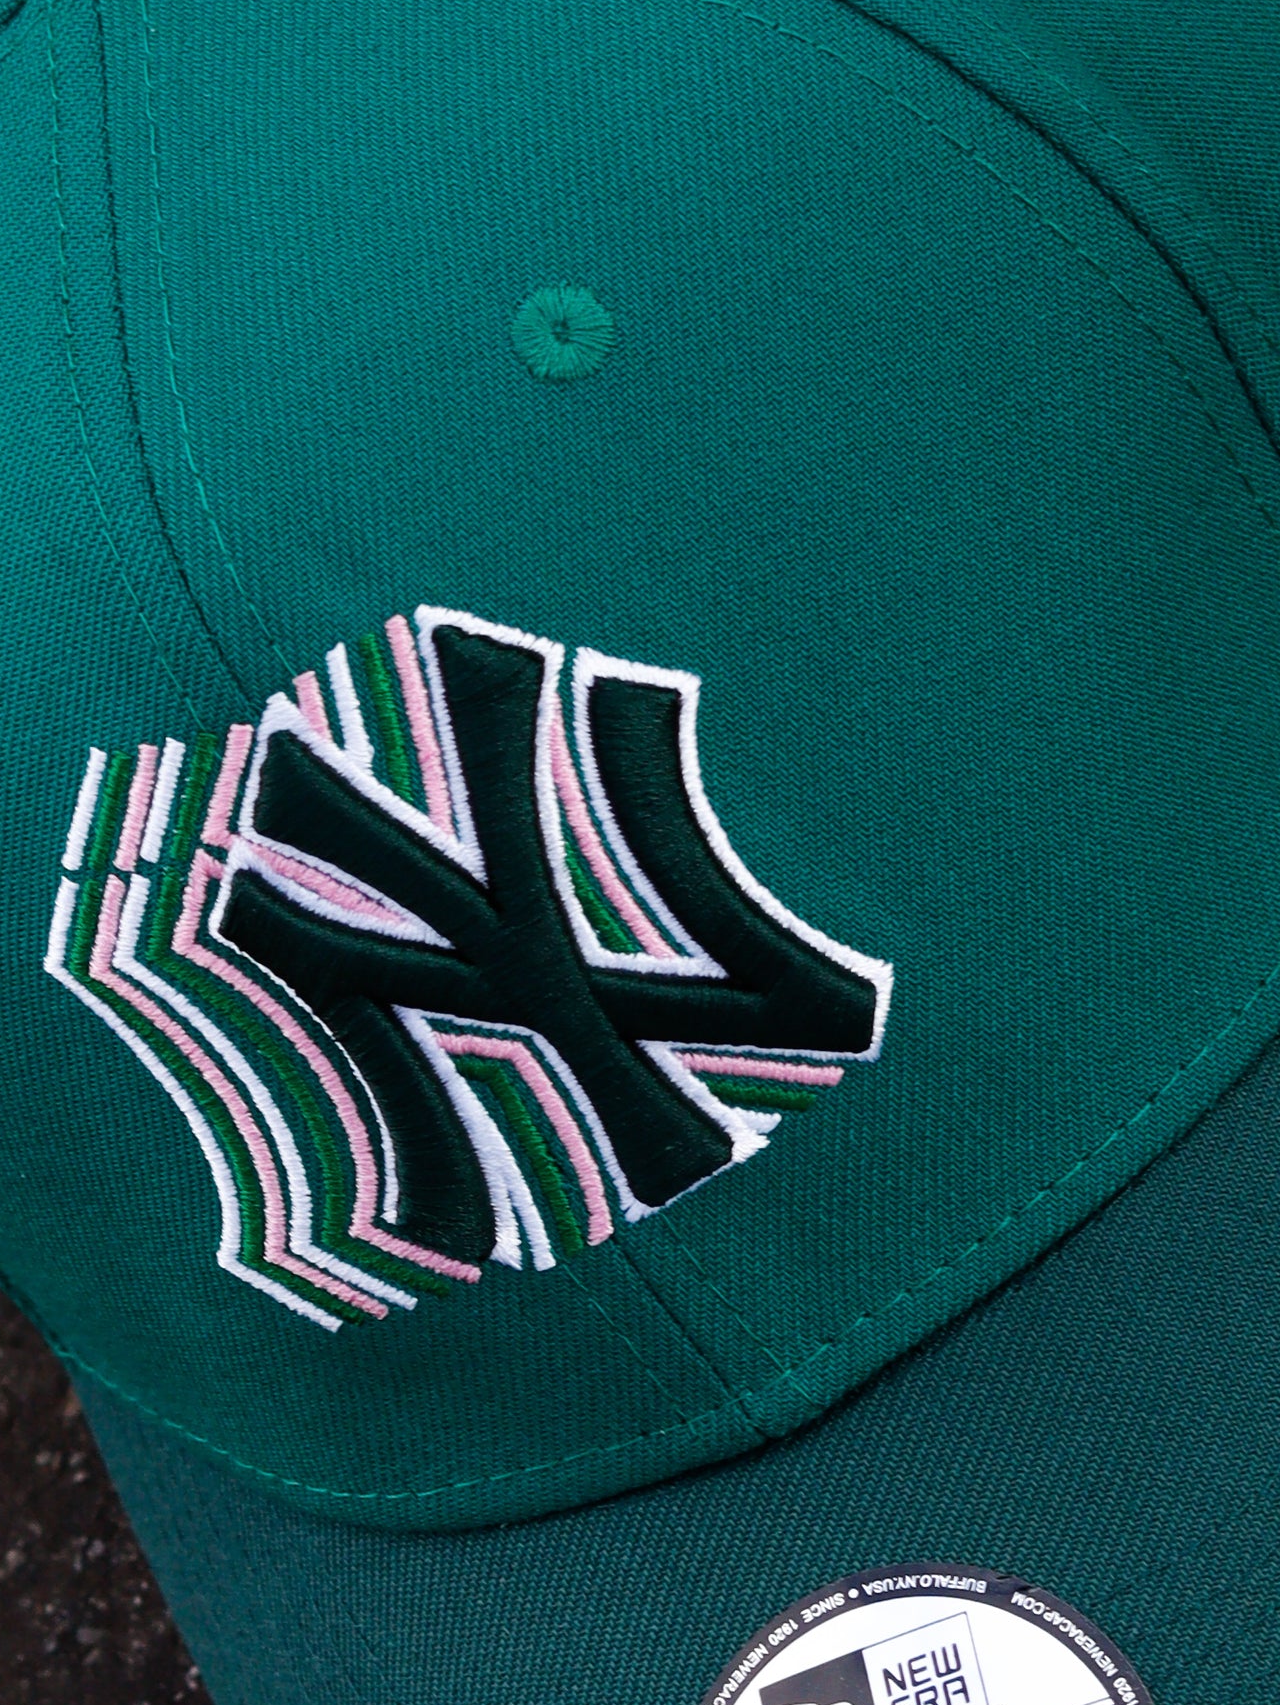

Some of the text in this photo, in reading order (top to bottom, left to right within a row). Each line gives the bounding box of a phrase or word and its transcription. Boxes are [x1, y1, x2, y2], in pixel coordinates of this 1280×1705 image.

[800, 1592, 846, 1624] SINCE
[767, 1618, 799, 1646] 1920
[882, 1643, 962, 1697] NEW
